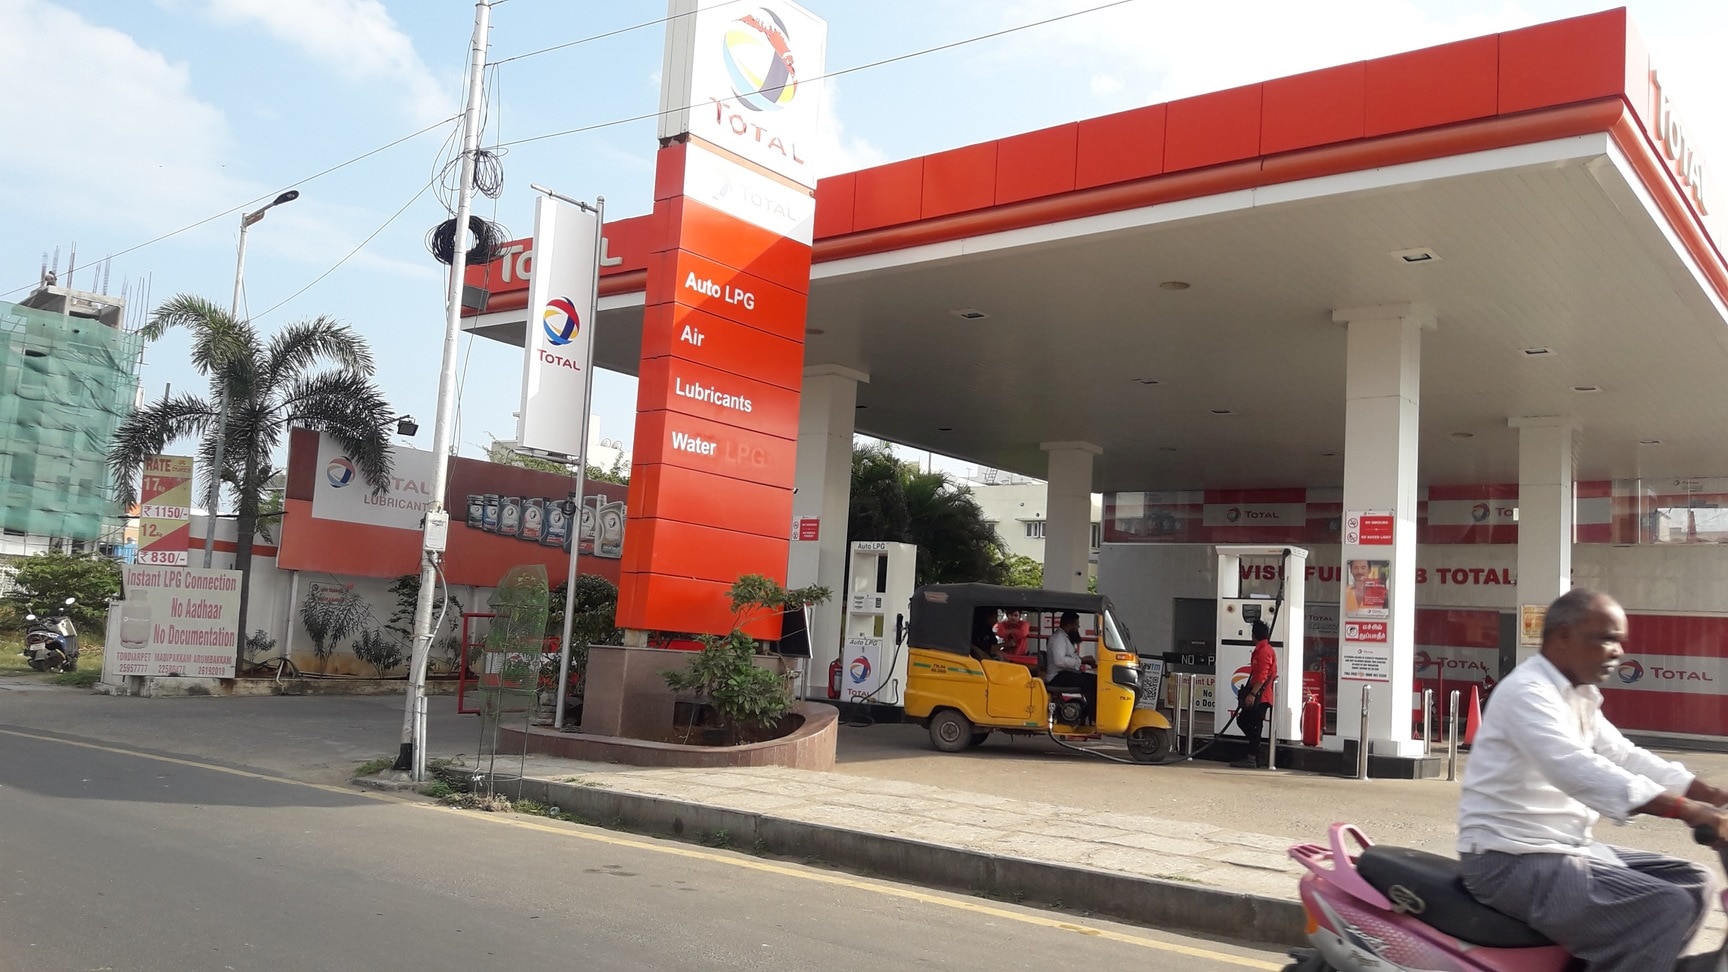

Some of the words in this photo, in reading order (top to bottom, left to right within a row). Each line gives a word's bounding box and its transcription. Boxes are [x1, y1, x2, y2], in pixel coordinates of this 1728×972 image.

[710, 96, 804, 165] TOTAL
[741, 184, 797, 222] TOTAL
[495, 236, 623, 283] TOL
[684, 271, 721, 299] Auto
[725, 284, 755, 310] LPG
[680, 324, 705, 347] Air
[537, 348, 581, 372] TOTAL
[675, 377, 752, 413] Lubricants
[672, 431, 717, 456] Water
[145, 458, 171, 473] RATE
[143, 476, 160, 491] 17
[155, 507, 188, 519] 1150/-
[1244, 510, 1279, 519] TOTAL
[141, 523, 157, 537] 12
[857, 542, 872, 550] Auto
[872, 542, 885, 550] LPG
[151, 552, 185, 564] 830/-
[127, 568, 161, 587] Instant
[163, 570, 182, 588] LPG
[184, 571, 237, 591] Connection
[1436, 568, 1512, 585] TOTAL
[170, 597, 183, 618] No
[185, 598, 223, 619] Aadhaar
[153, 623, 165, 644] No
[168, 624, 235, 647] Documentation
[116, 652, 151, 662] TONDIARPET
[1181, 654, 1195, 665] NO
[1437, 656, 1488, 671] TOTAL
[1650, 666, 1713, 682] TOTAL
[847, 688, 870, 696] TOTAL
[1203, 689, 1213, 697] No
[1202, 699, 1216, 708] Doc
